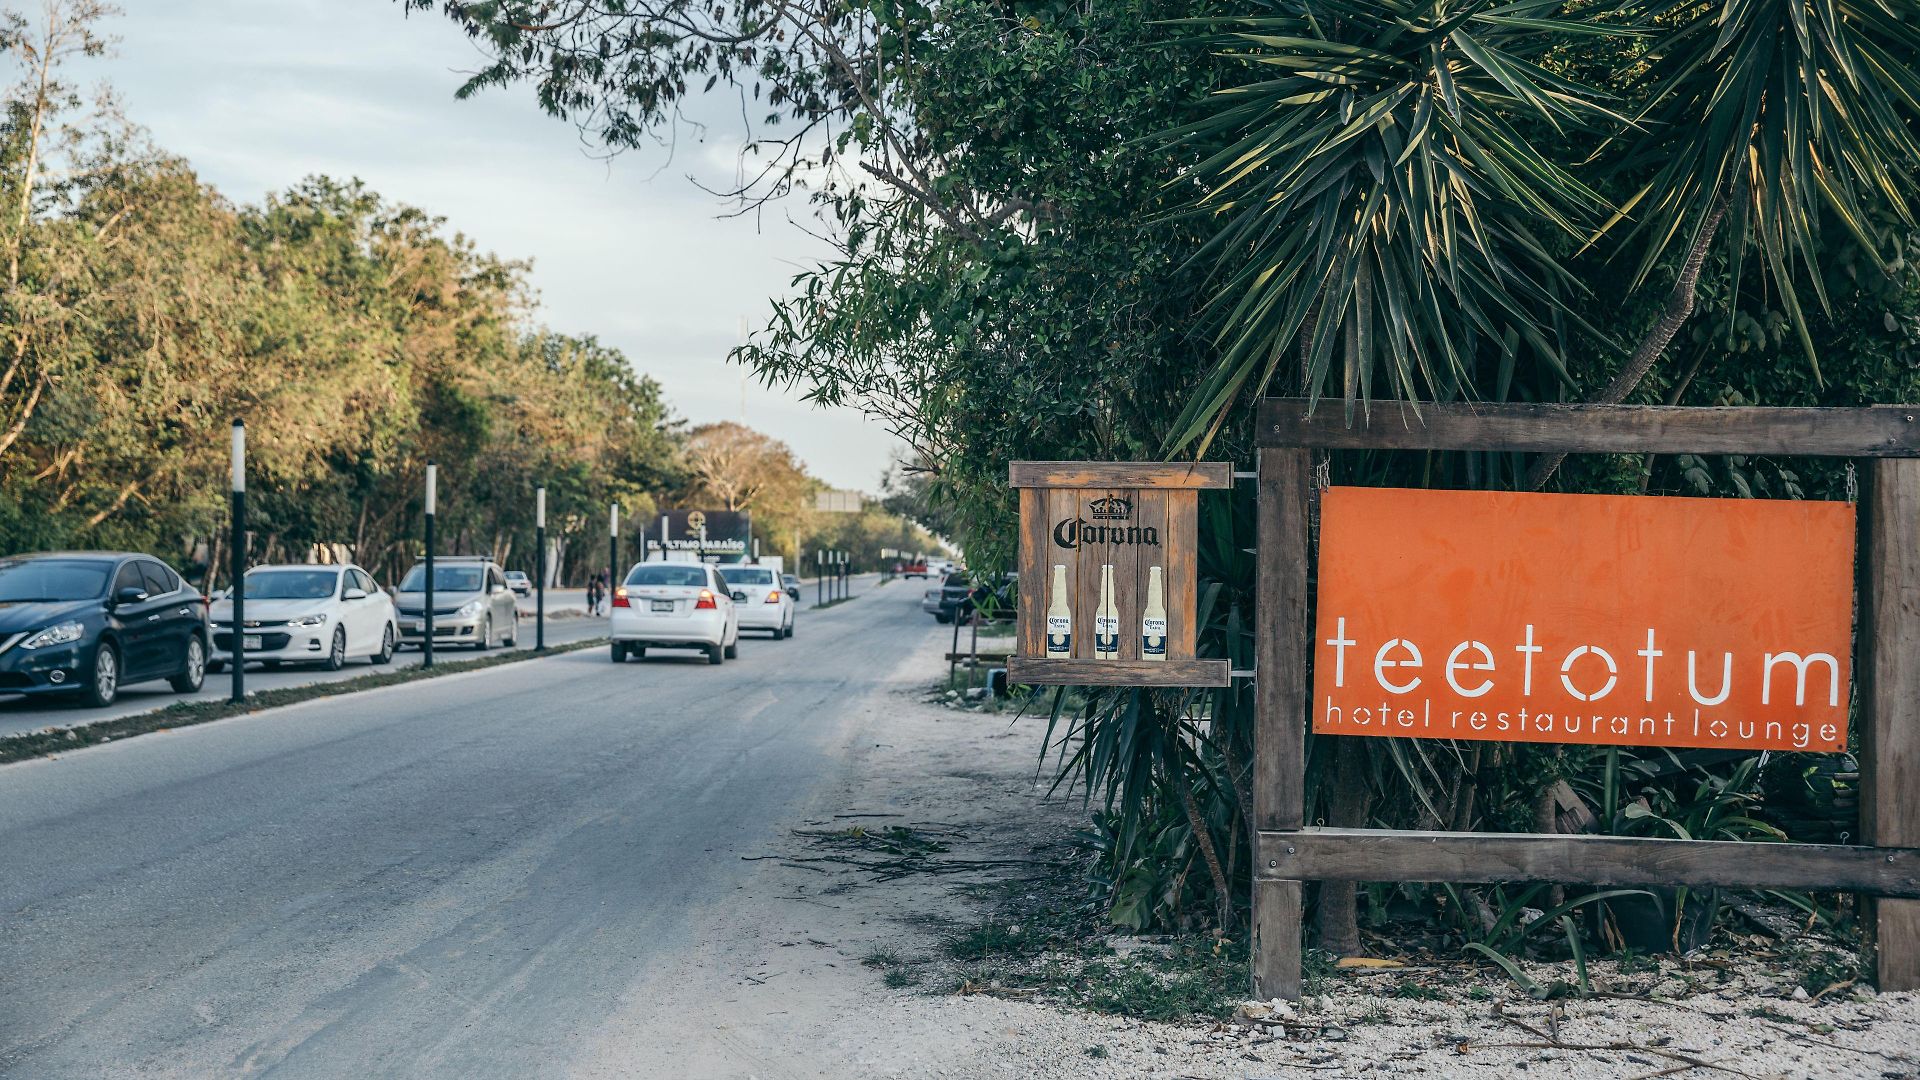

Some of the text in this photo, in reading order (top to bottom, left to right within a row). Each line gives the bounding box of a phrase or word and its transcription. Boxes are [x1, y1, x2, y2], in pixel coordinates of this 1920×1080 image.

[647, 540, 660, 550] EL
[1053, 517, 1160, 552] Corona
[1326, 617, 1839, 707] teetotum
[1326, 695, 1837, 748] hotel restaurant lounge
